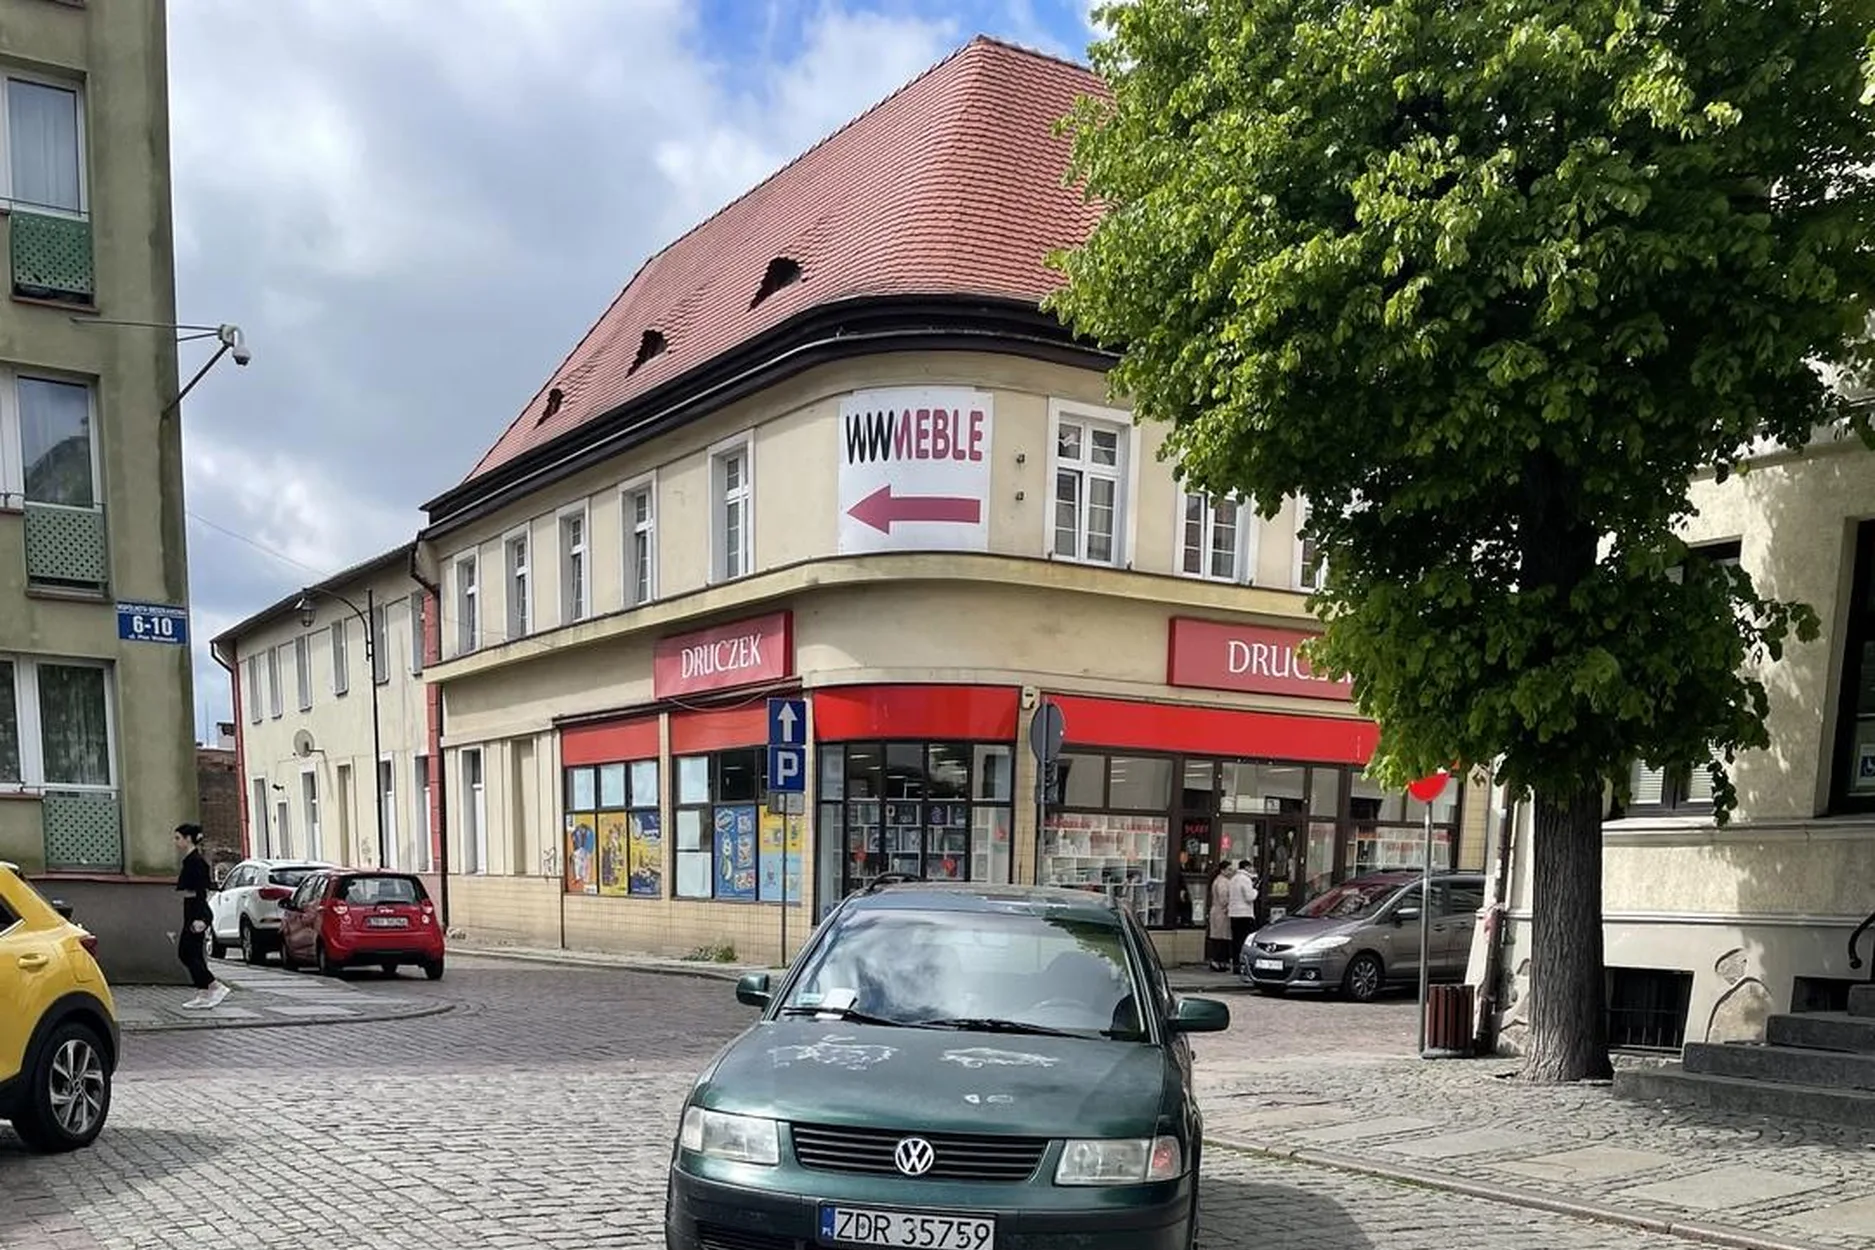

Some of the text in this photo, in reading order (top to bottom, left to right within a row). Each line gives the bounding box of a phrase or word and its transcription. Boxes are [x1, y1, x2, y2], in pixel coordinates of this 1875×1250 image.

[133, 615, 173, 636] 6-10
[681, 633, 762, 678] DRUCZEK
[1228, 640, 1352, 683] DRUC
[777, 750, 799, 786] P
[836, 1210, 990, 1250] ZDR 35759
